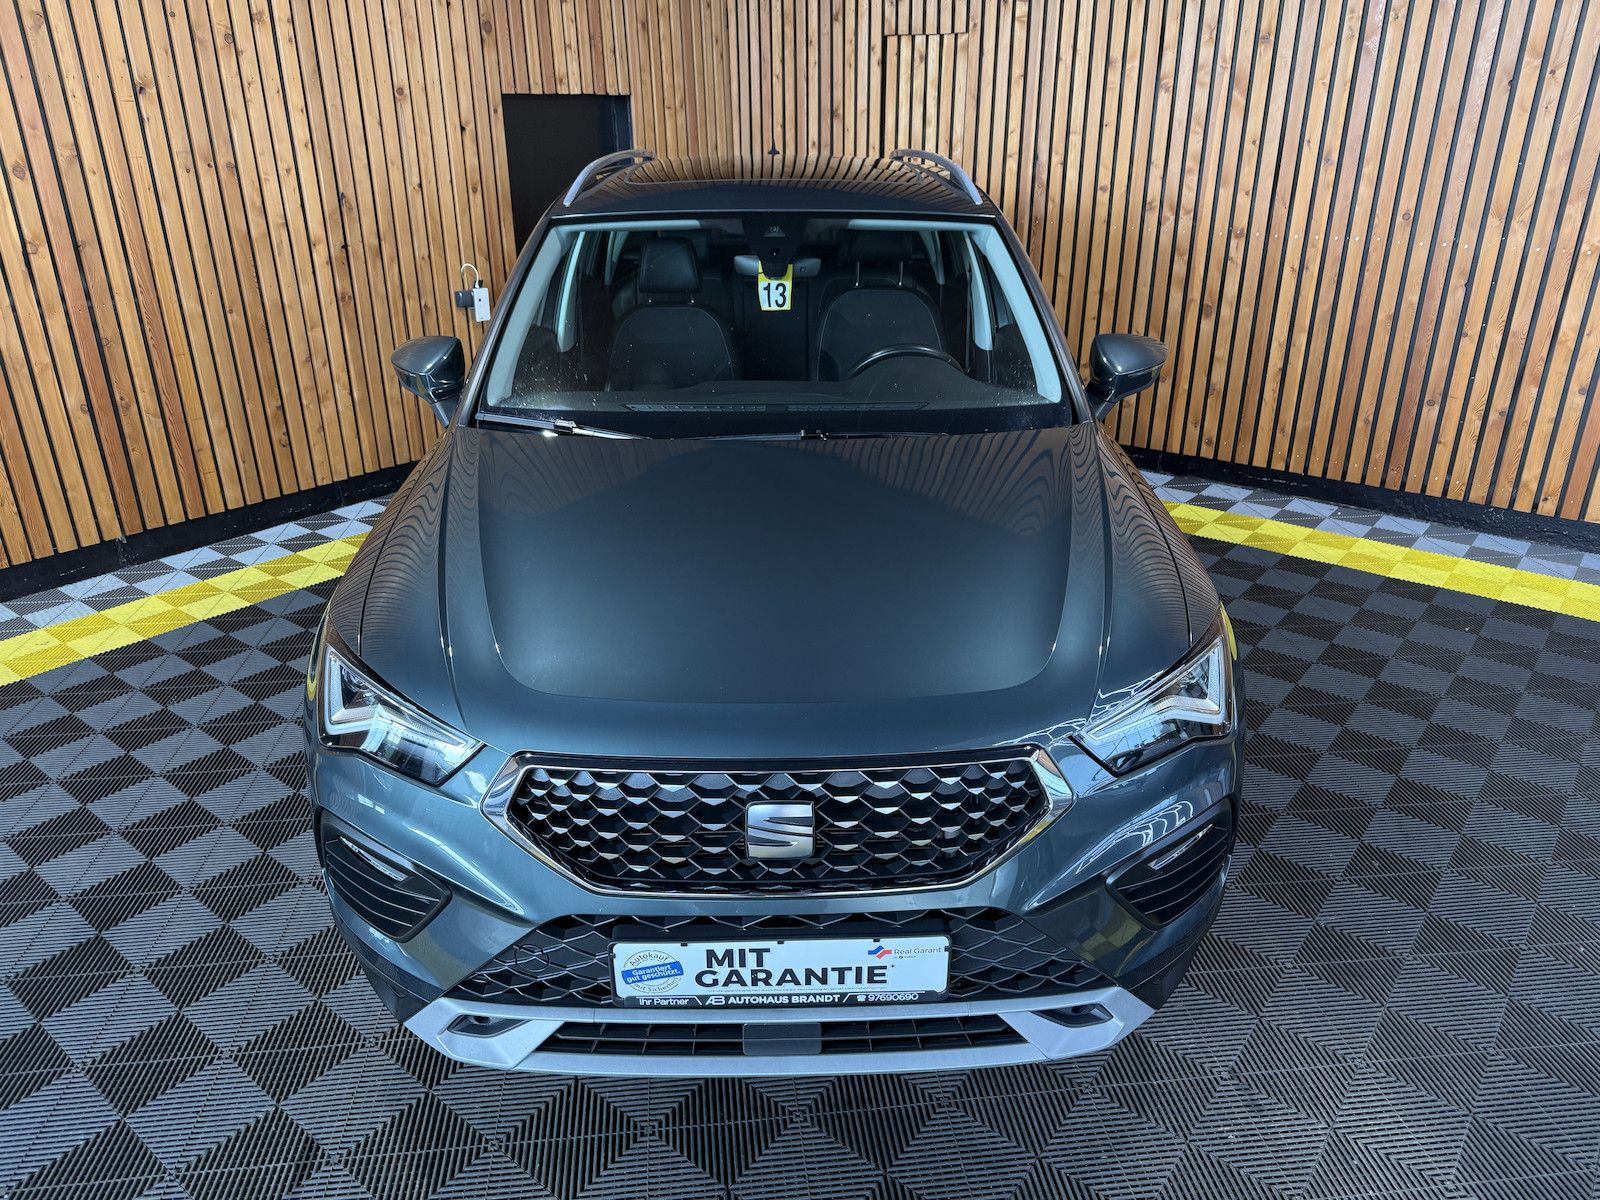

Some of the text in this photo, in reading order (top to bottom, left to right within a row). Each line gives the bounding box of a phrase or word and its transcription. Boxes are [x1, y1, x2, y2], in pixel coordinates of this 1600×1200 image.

[763, 282, 787, 308] 13
[630, 952, 668, 966] Autokauf
[706, 948, 770, 968] MIT
[727, 995, 789, 1004] AUTOHAUS
[791, 994, 840, 1004] BRANDT
[867, 993, 919, 1002] 97690690
